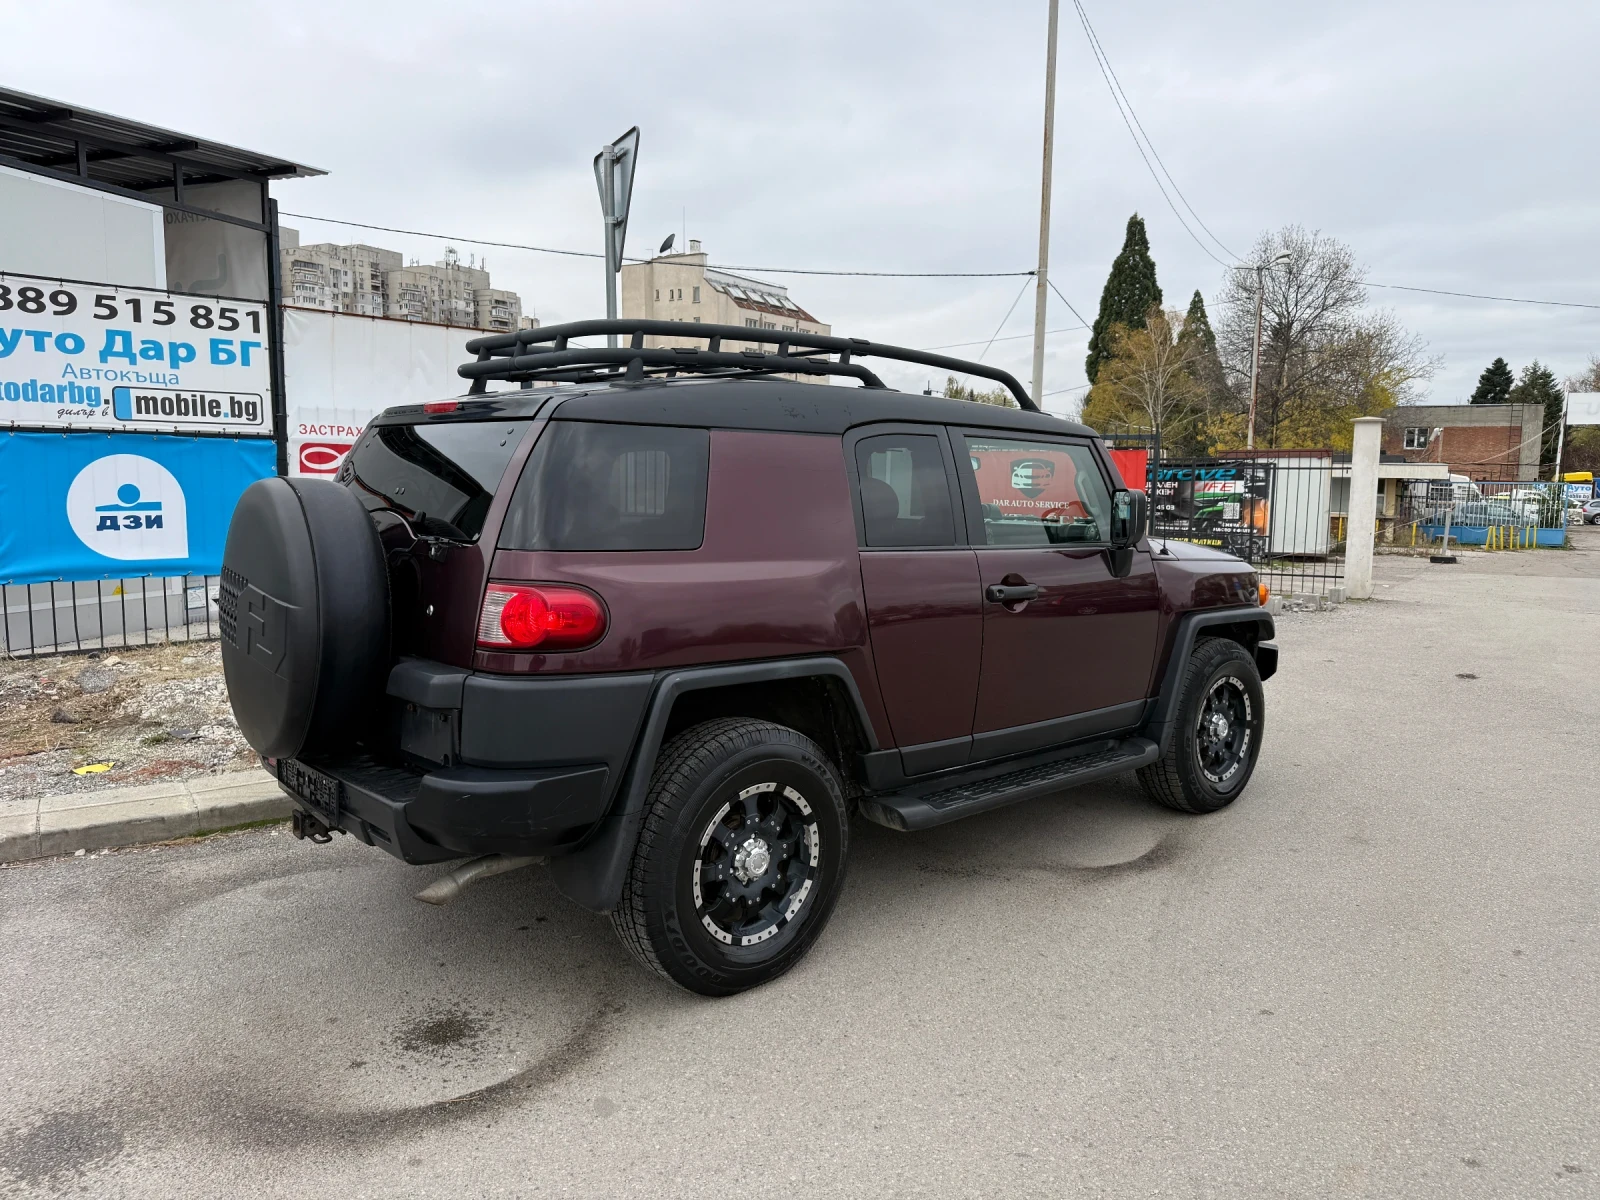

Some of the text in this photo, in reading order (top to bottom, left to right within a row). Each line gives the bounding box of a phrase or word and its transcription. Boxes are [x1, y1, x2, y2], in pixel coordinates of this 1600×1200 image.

[93, 294, 176, 326] 515
[189, 304, 261, 334] 851
[98, 328, 197, 370] Дар
[209, 337, 261, 367] БГ
[61, 362, 180, 387] Автокъща
[135, 393, 258, 422] mobile.bg
[992, 498, 1070, 510] DAR AUTO SERVICE
[96, 514, 164, 532] ДЗИ
